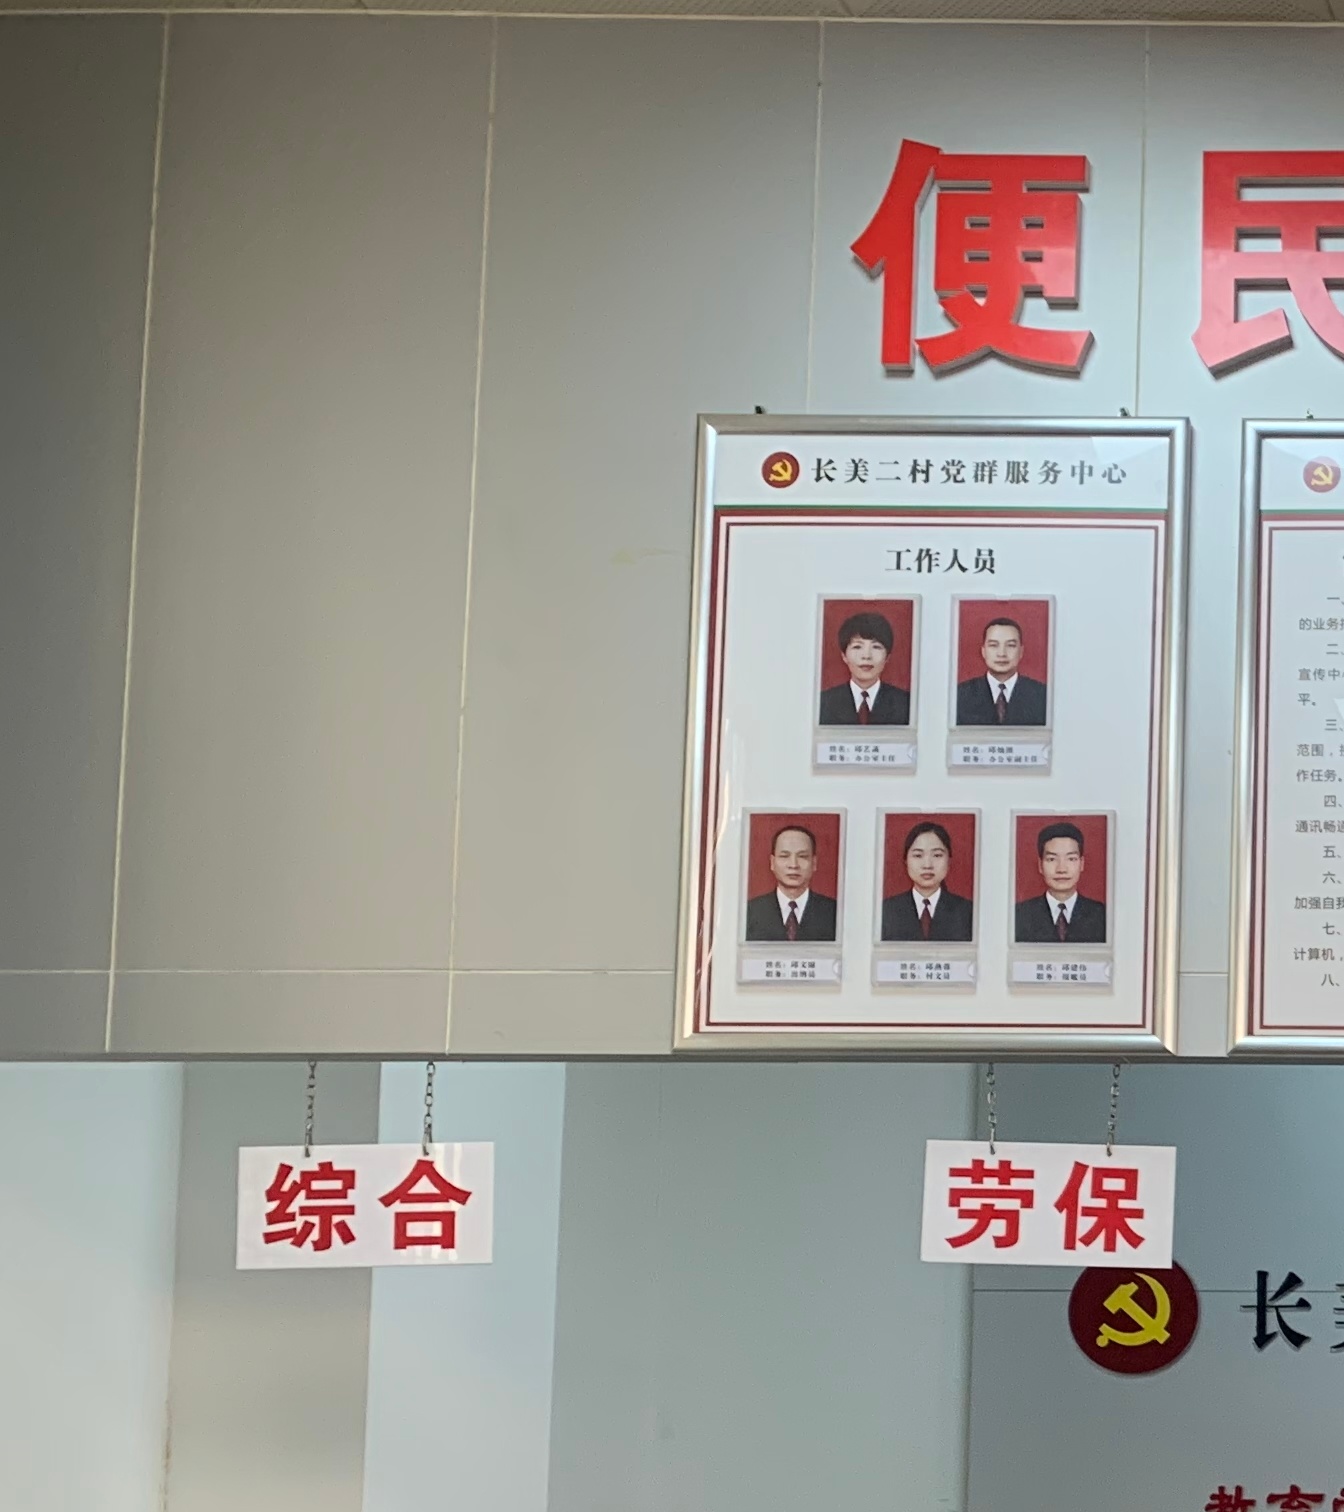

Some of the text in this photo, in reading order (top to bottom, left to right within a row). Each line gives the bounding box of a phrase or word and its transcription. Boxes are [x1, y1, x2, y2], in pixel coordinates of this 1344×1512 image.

[811, 457, 1130, 485] 长美二村党群服务中心
[886, 548, 997, 574] 工作人员
[1296, 769, 1343, 783] 作任务。
[262, 1158, 473, 1254] 综合
[945, 1158, 1147, 1254] 劳保
